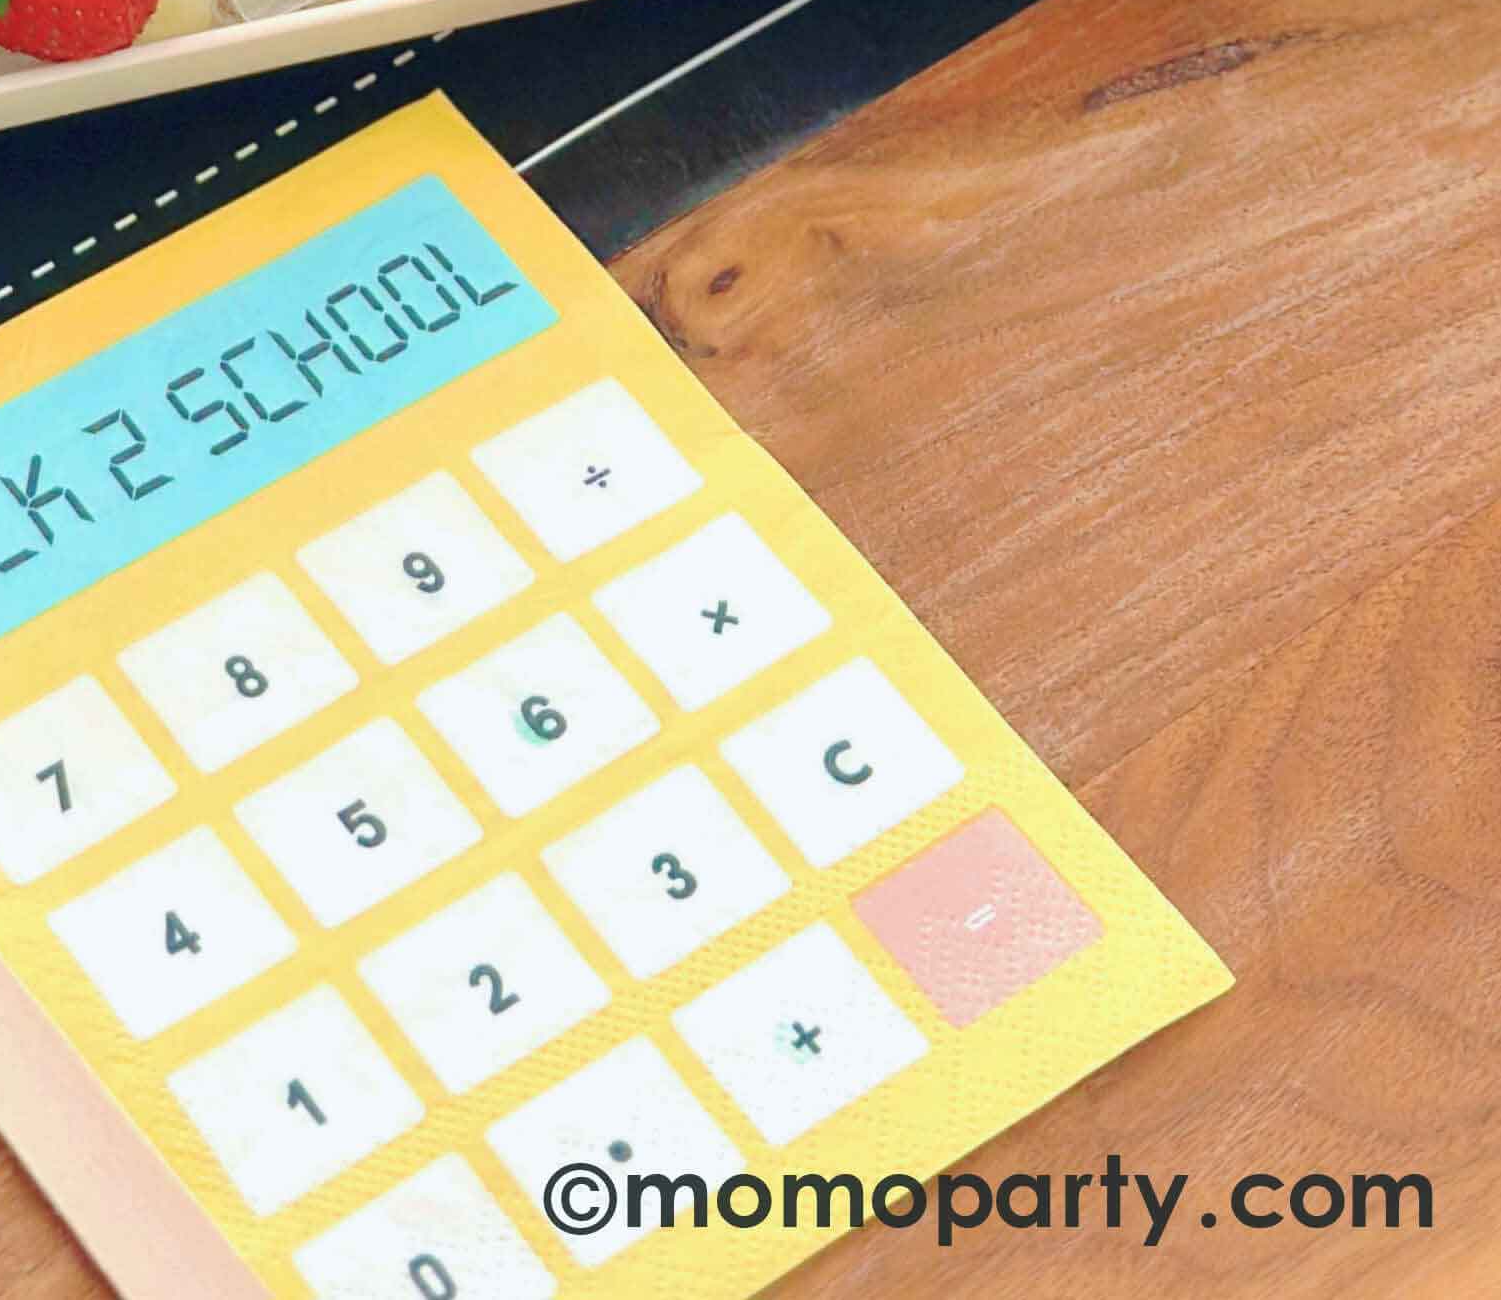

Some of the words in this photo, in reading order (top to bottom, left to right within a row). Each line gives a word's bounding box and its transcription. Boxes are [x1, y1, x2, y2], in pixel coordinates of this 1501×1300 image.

[81, 408, 177, 501] 2
[165, 242, 521, 457] SCHOOL
[35, 758, 76, 814] 7
[224, 655, 270, 700] 8
[400, 551, 447, 595] 9
[163, 909, 202, 960] 4
[336, 798, 388, 850] 5
[519, 695, 568, 742] 6
[285, 1076, 329, 1128] 1
[468, 962, 520, 1016] 2
[650, 852, 699, 902] 3
[822, 739, 874, 787] C
[408, 1254, 456, 1300] 0
